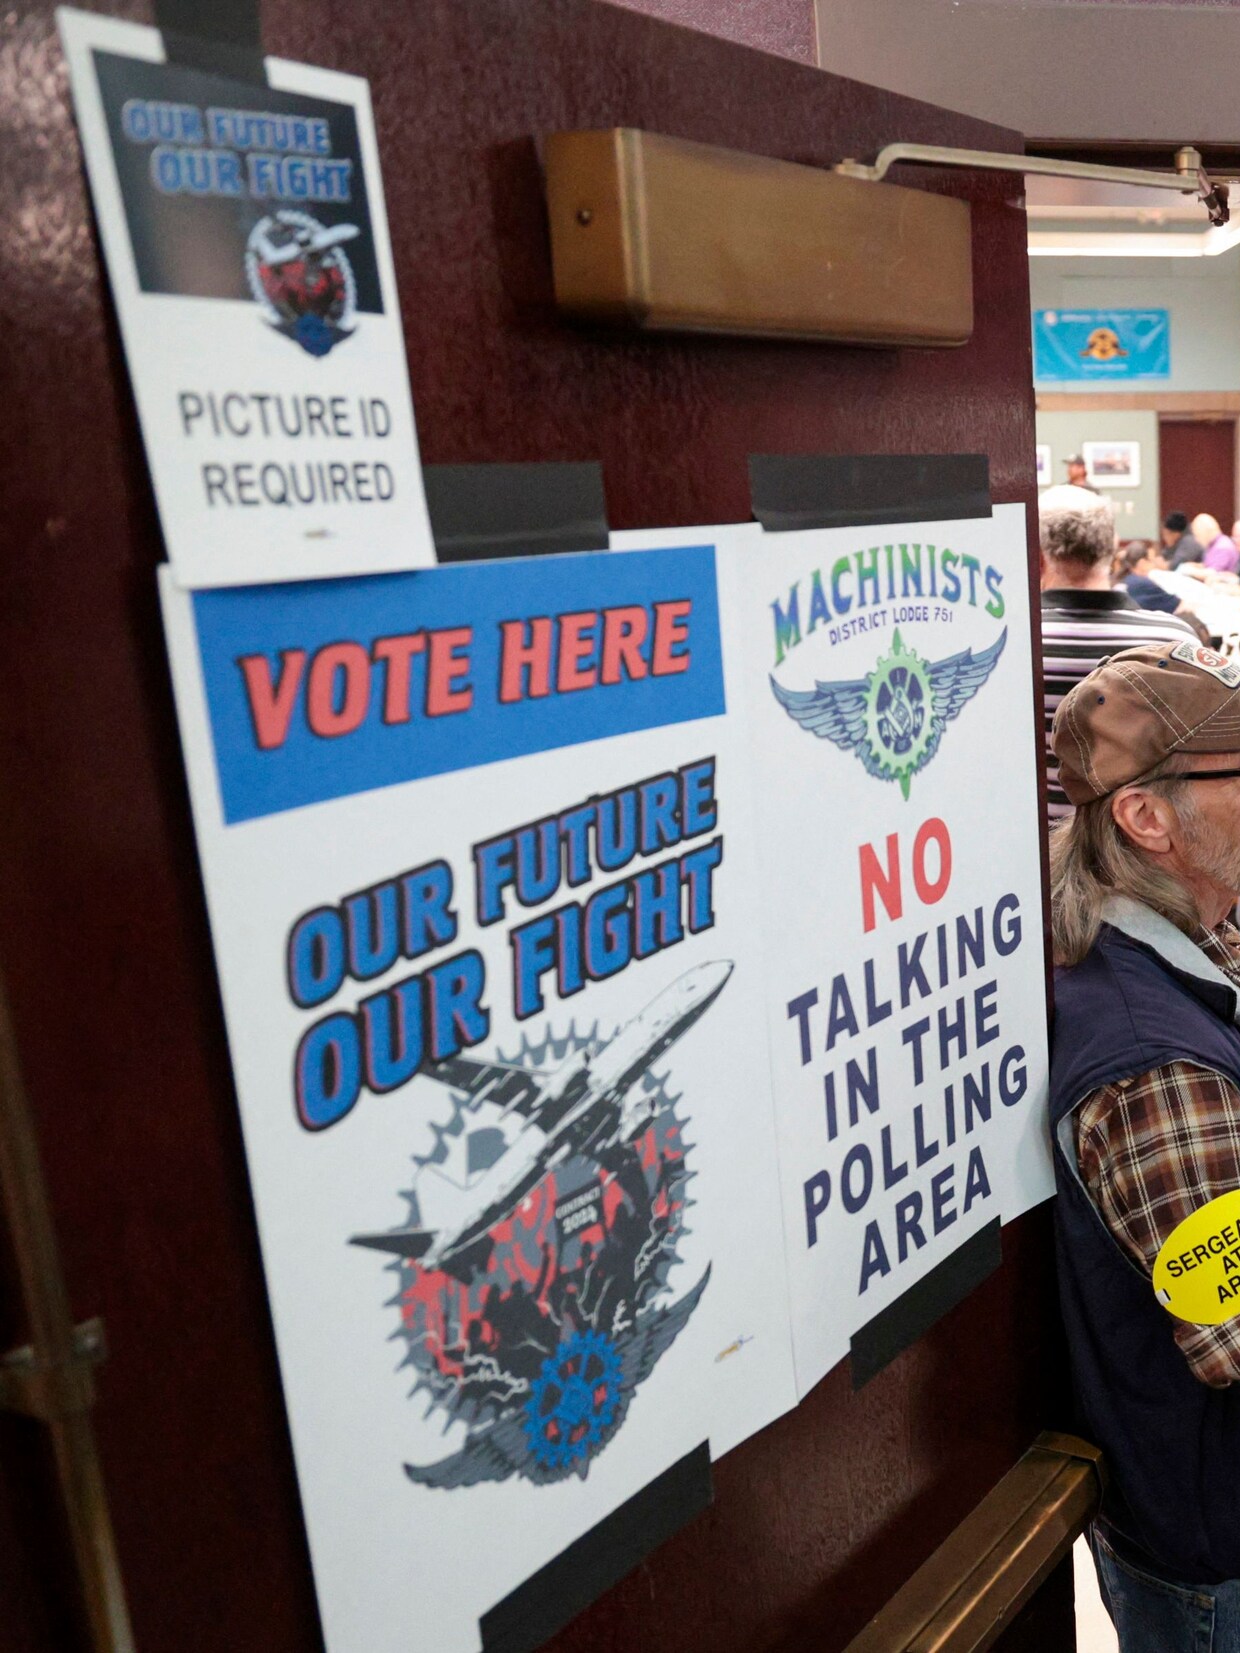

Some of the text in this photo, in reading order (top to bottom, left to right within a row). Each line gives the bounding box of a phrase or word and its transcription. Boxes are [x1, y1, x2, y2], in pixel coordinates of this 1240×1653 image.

[123, 100, 332, 156] OUR FUTURE
[151, 146, 352, 203] OUR FIGHT
[178, 391, 392, 439] PICTURE ID
[203, 462, 396, 507] REQUIRED
[769, 542, 1006, 668] MACHINISTS
[829, 606, 953, 646] DISTRICT LODGE 751
[237, 599, 692, 751] VOTE HERE
[286, 755, 717, 1010] OUR FUTURE
[857, 817, 952, 934] NO
[293, 835, 724, 1133] OUR FIGHT
[786, 893, 1023, 1066] TALKING
[824, 979, 1000, 1142] IN THE
[804, 1045, 1028, 1249] POLLING
[858, 1145, 992, 1297] AREA
